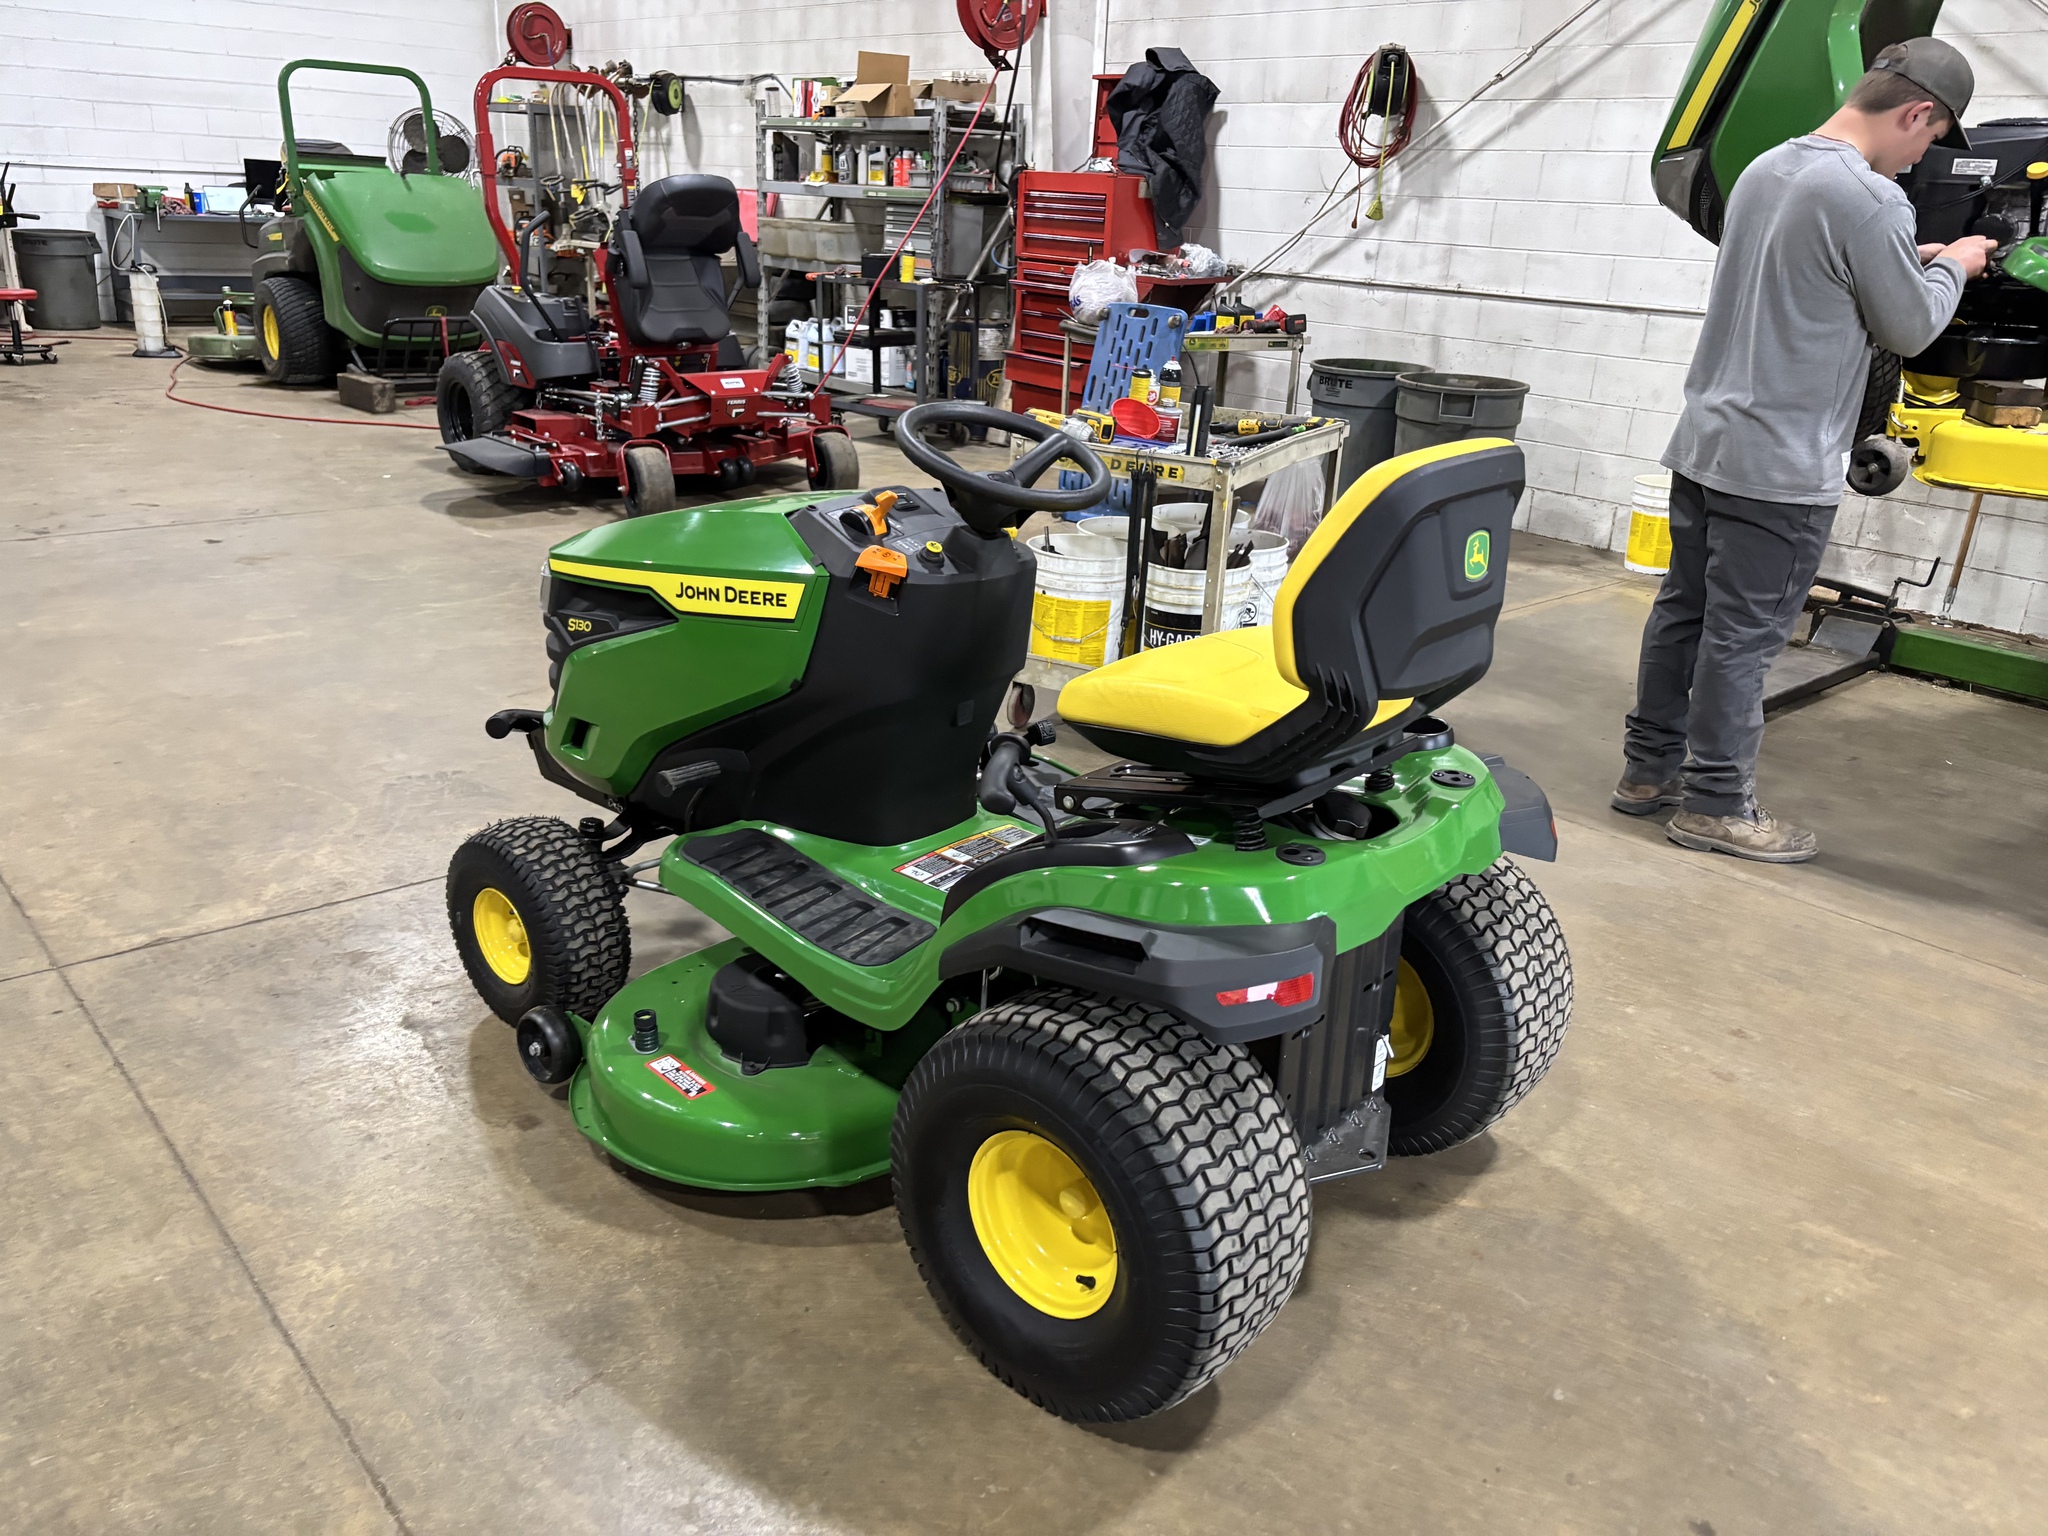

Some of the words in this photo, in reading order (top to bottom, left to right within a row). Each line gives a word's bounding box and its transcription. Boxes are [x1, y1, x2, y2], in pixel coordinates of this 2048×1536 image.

[1319, 375, 1353, 389] BRUTE
[676, 581, 720, 602] JOHN
[725, 586, 788, 608] DEERE
[567, 618, 592, 633] S130
